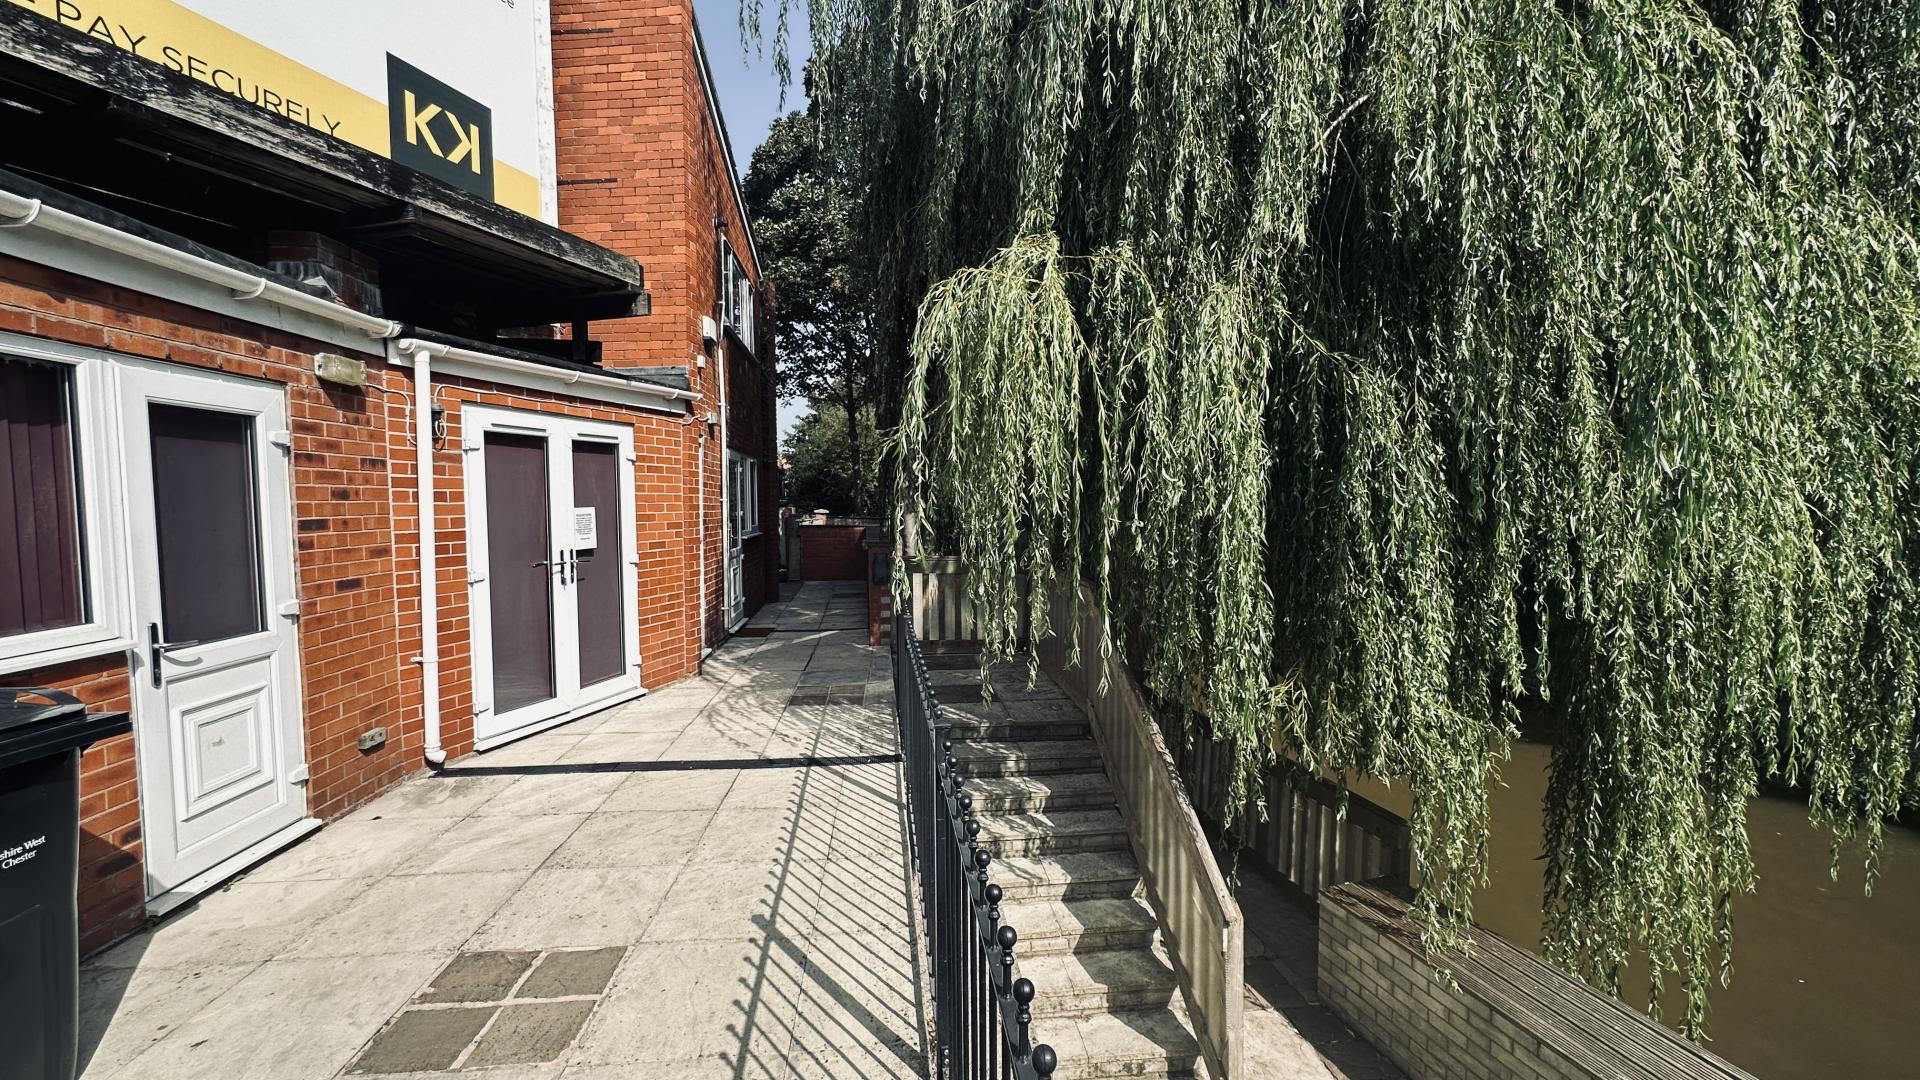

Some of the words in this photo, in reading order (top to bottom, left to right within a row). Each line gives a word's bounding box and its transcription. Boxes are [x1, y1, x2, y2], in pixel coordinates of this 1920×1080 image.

[56, 0, 147, 54] PAY
[0, 846, 23, 861] shire
[24, 835, 46, 850] West
[2, 850, 37, 869] Chester
